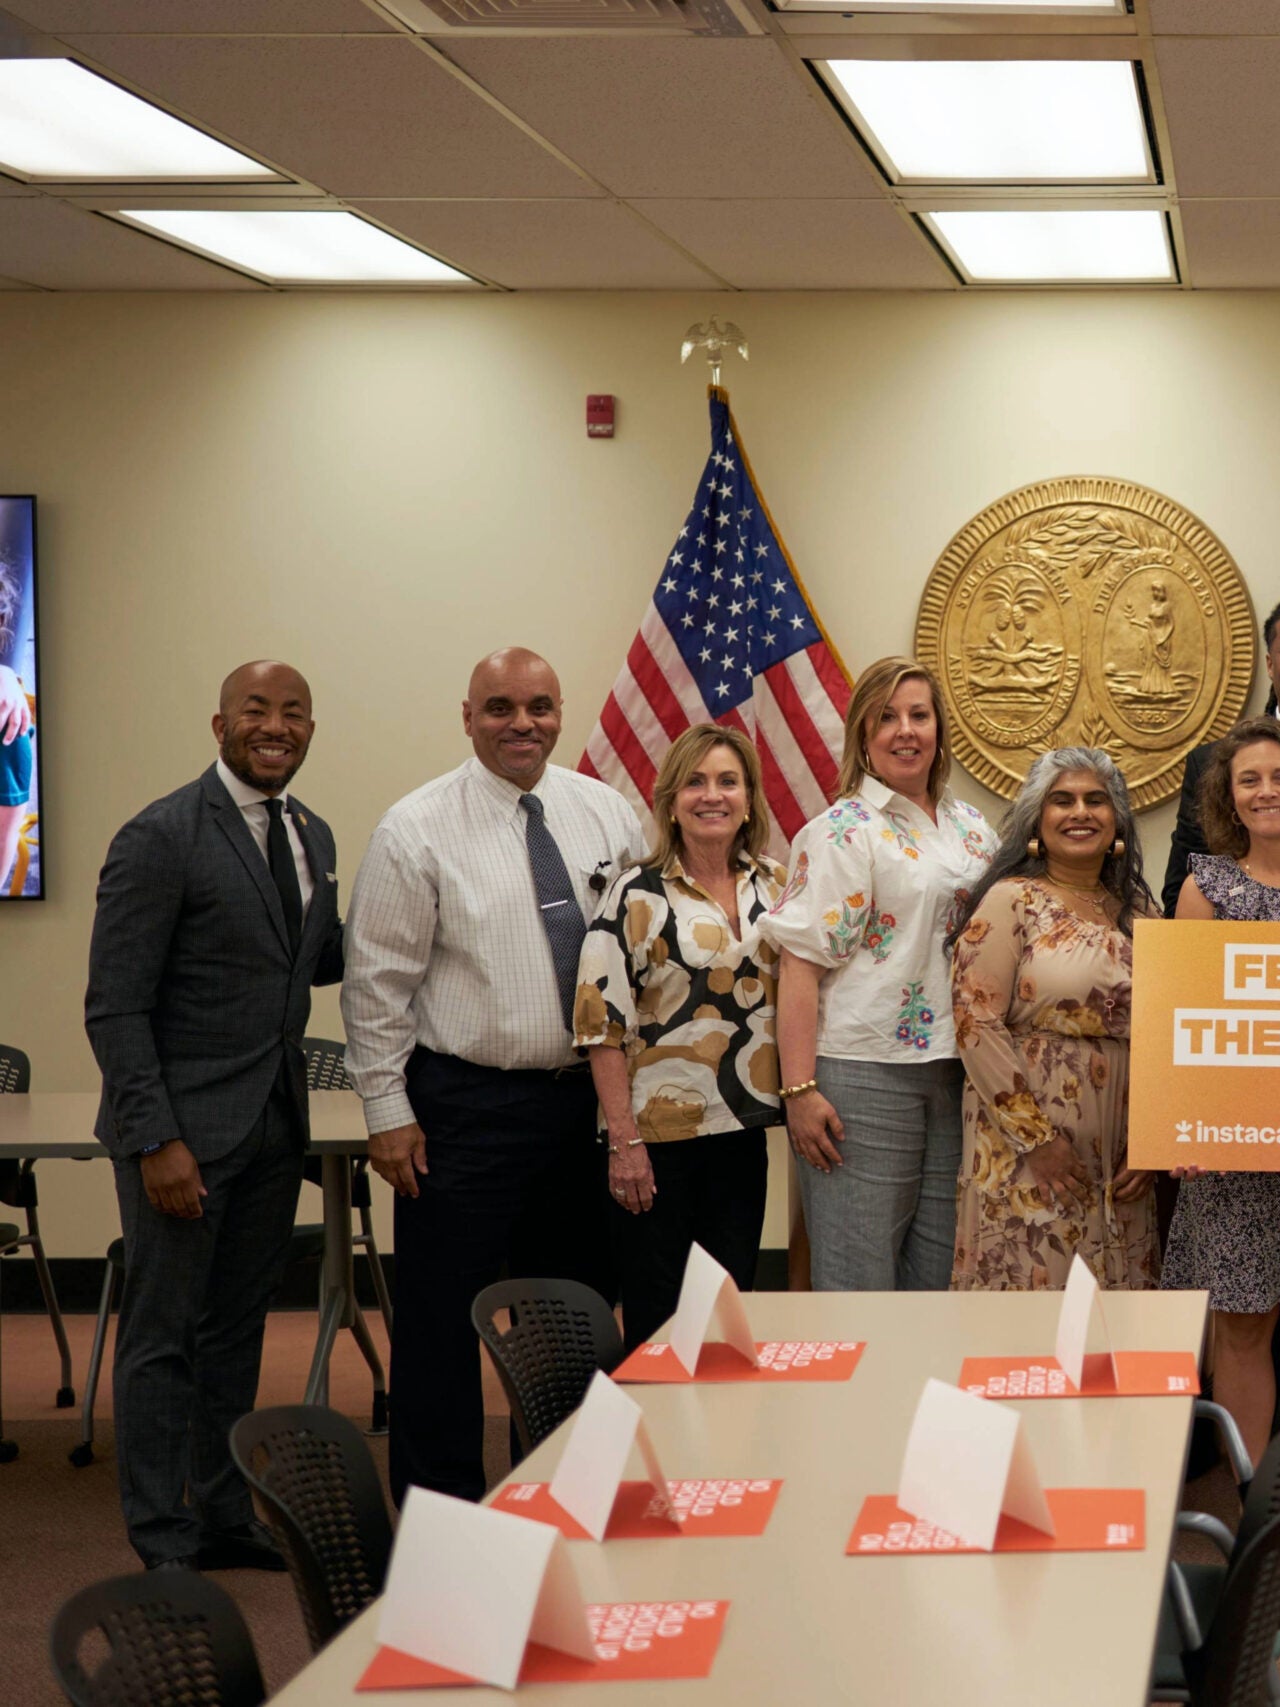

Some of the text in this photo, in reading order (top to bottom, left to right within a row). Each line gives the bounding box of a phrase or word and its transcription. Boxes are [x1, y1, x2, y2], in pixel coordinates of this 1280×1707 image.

[956, 557, 996, 609] SOUTH
[1093, 574, 1120, 616] DUM
[1180, 562, 1214, 617] SPERO
[949, 654, 976, 719] ANIMIS
[1055, 654, 1081, 711] PARATI
